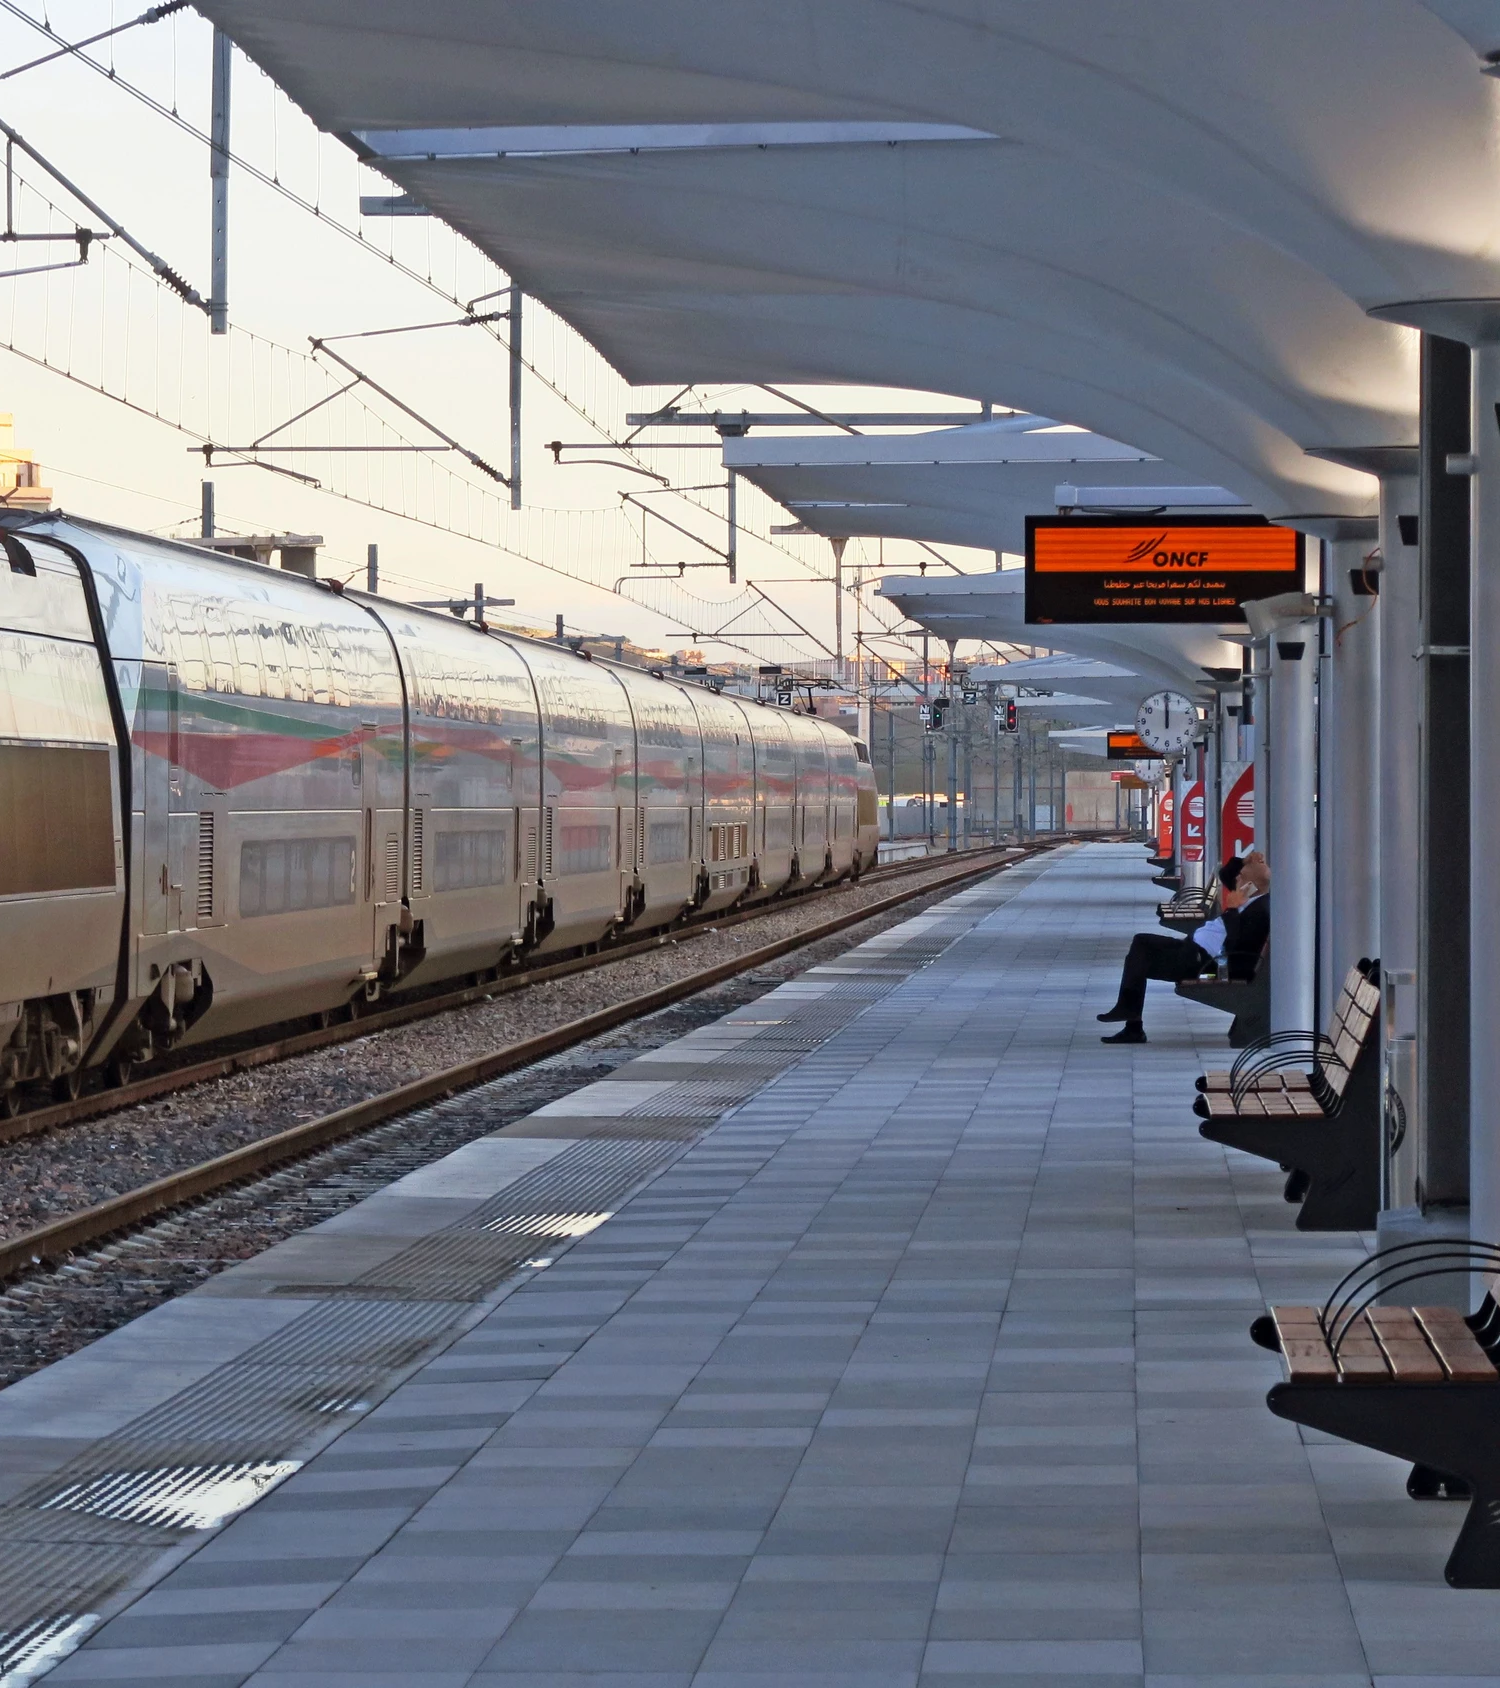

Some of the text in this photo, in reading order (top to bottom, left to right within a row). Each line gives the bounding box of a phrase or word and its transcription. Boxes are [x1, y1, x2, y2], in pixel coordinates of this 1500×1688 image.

[1153, 552, 1208, 567] ONCF
[780, 695, 789, 704] Z
[1185, 707, 1191, 715] 2
